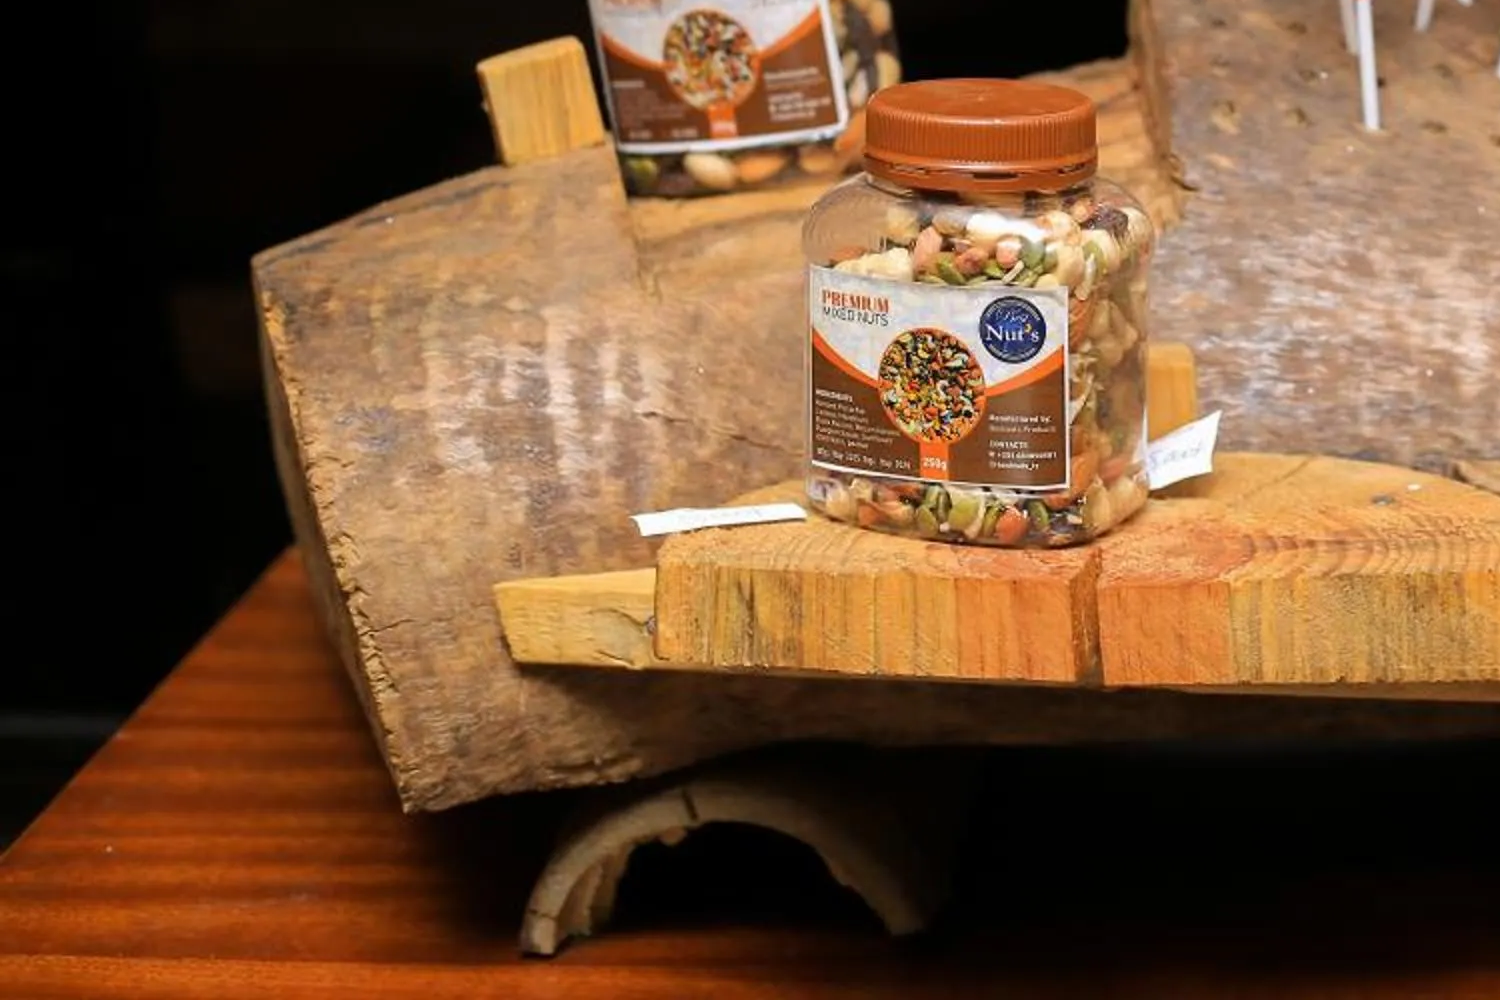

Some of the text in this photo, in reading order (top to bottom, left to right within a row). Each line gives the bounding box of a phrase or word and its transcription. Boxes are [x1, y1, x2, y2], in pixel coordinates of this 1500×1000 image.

[822, 290, 889, 313] PREMIUM
[823, 307, 889, 327] MIXED NUTS
